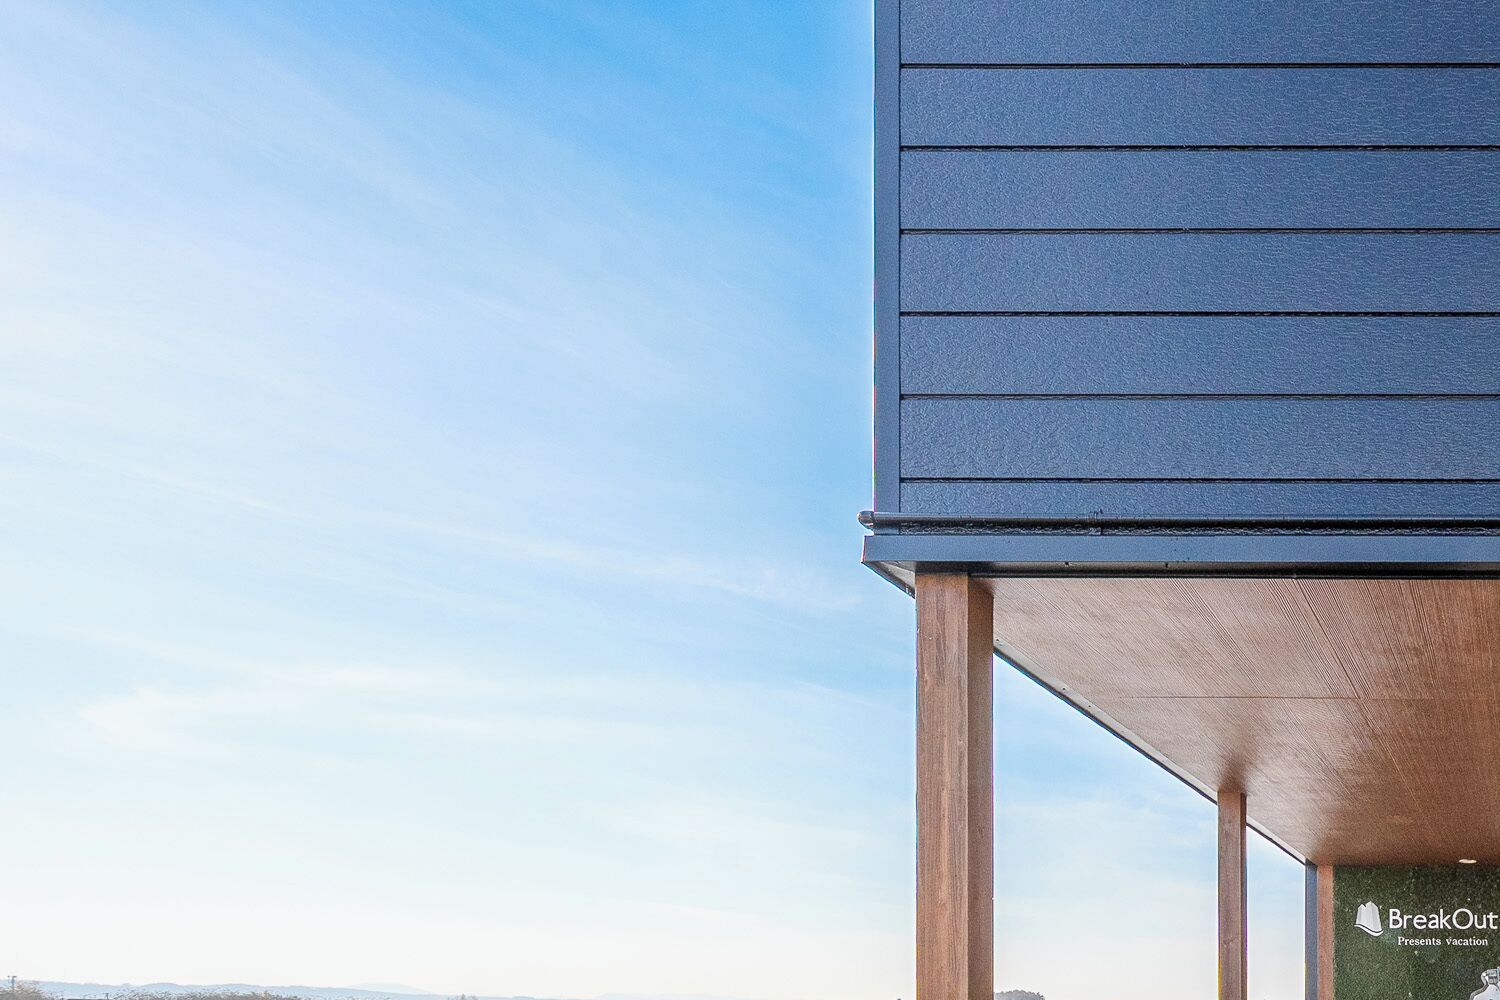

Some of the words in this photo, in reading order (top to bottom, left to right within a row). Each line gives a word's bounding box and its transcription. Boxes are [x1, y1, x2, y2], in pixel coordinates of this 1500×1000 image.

[1388, 908, 1499, 930] BreakOut
[1397, 936, 1442, 946] Presents
[1446, 936, 1489, 946] vacation
